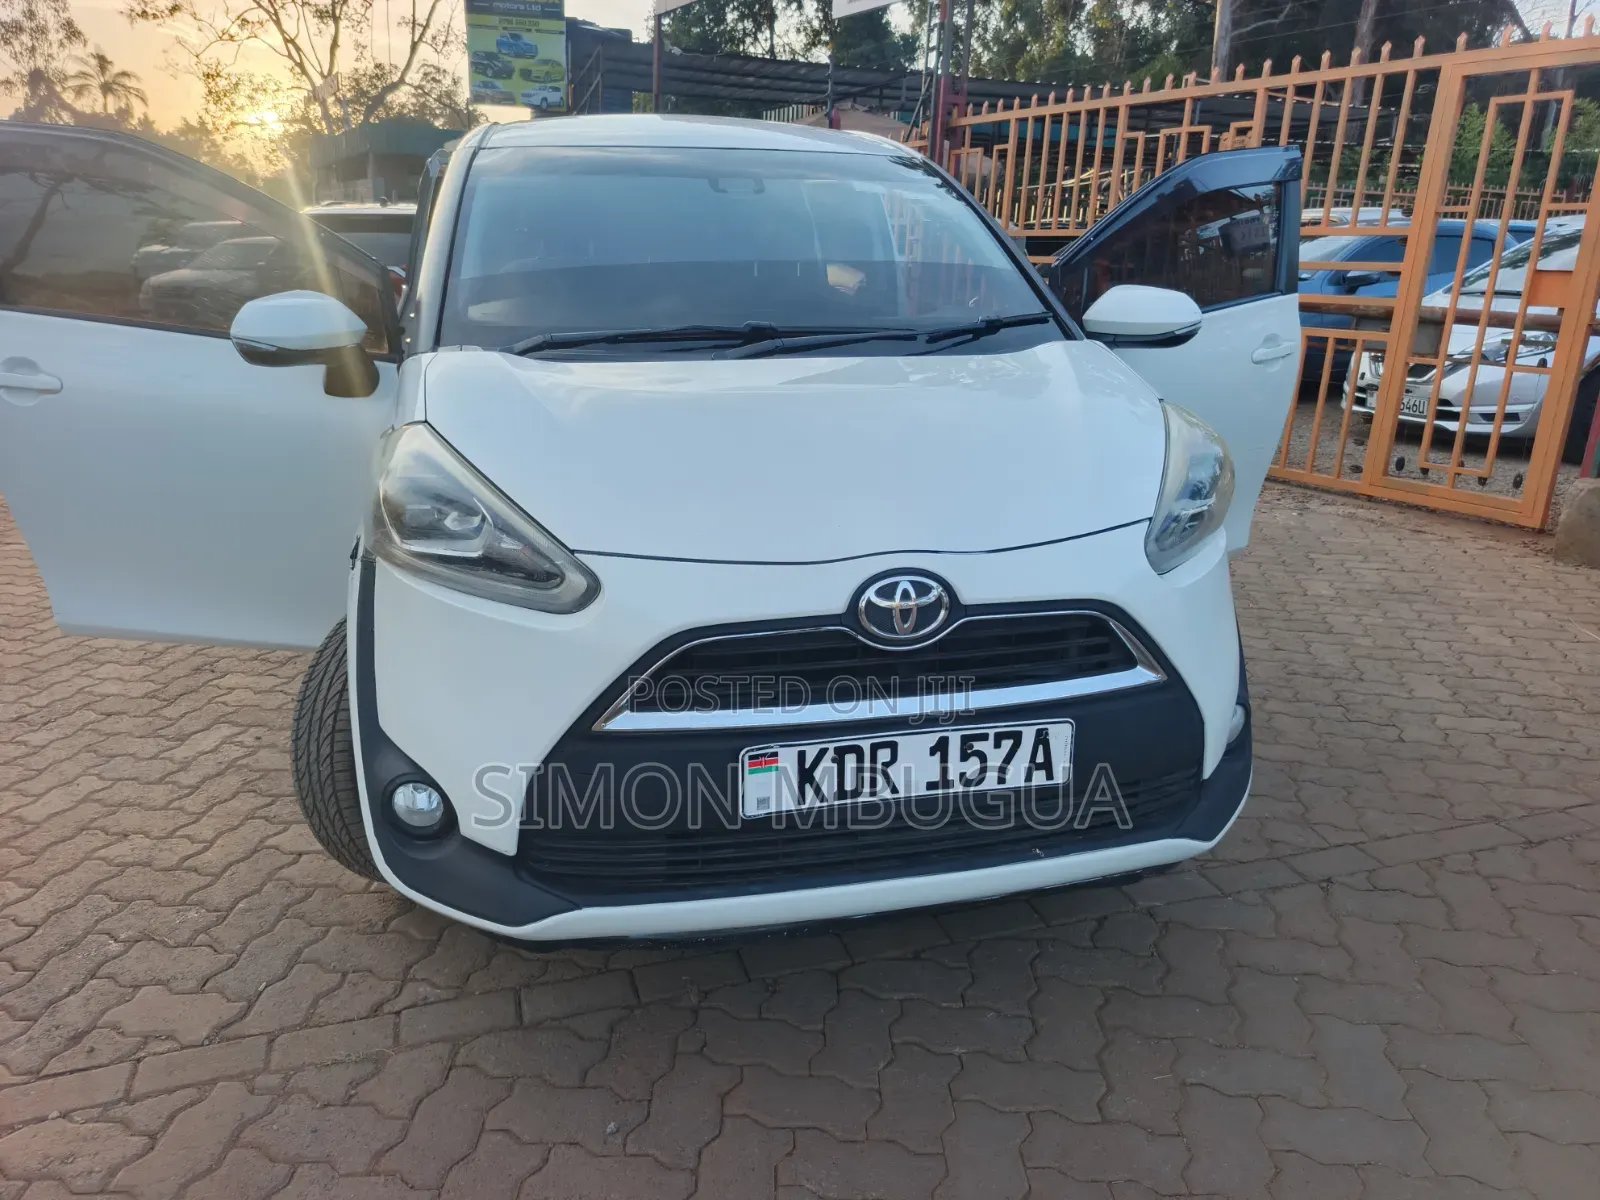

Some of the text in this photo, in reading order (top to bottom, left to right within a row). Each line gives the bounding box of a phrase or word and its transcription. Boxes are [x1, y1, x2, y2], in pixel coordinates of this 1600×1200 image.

[493, 2, 525, 10] motors
[797, 740, 900, 805] KDR
[925, 727, 1055, 791] 157A
